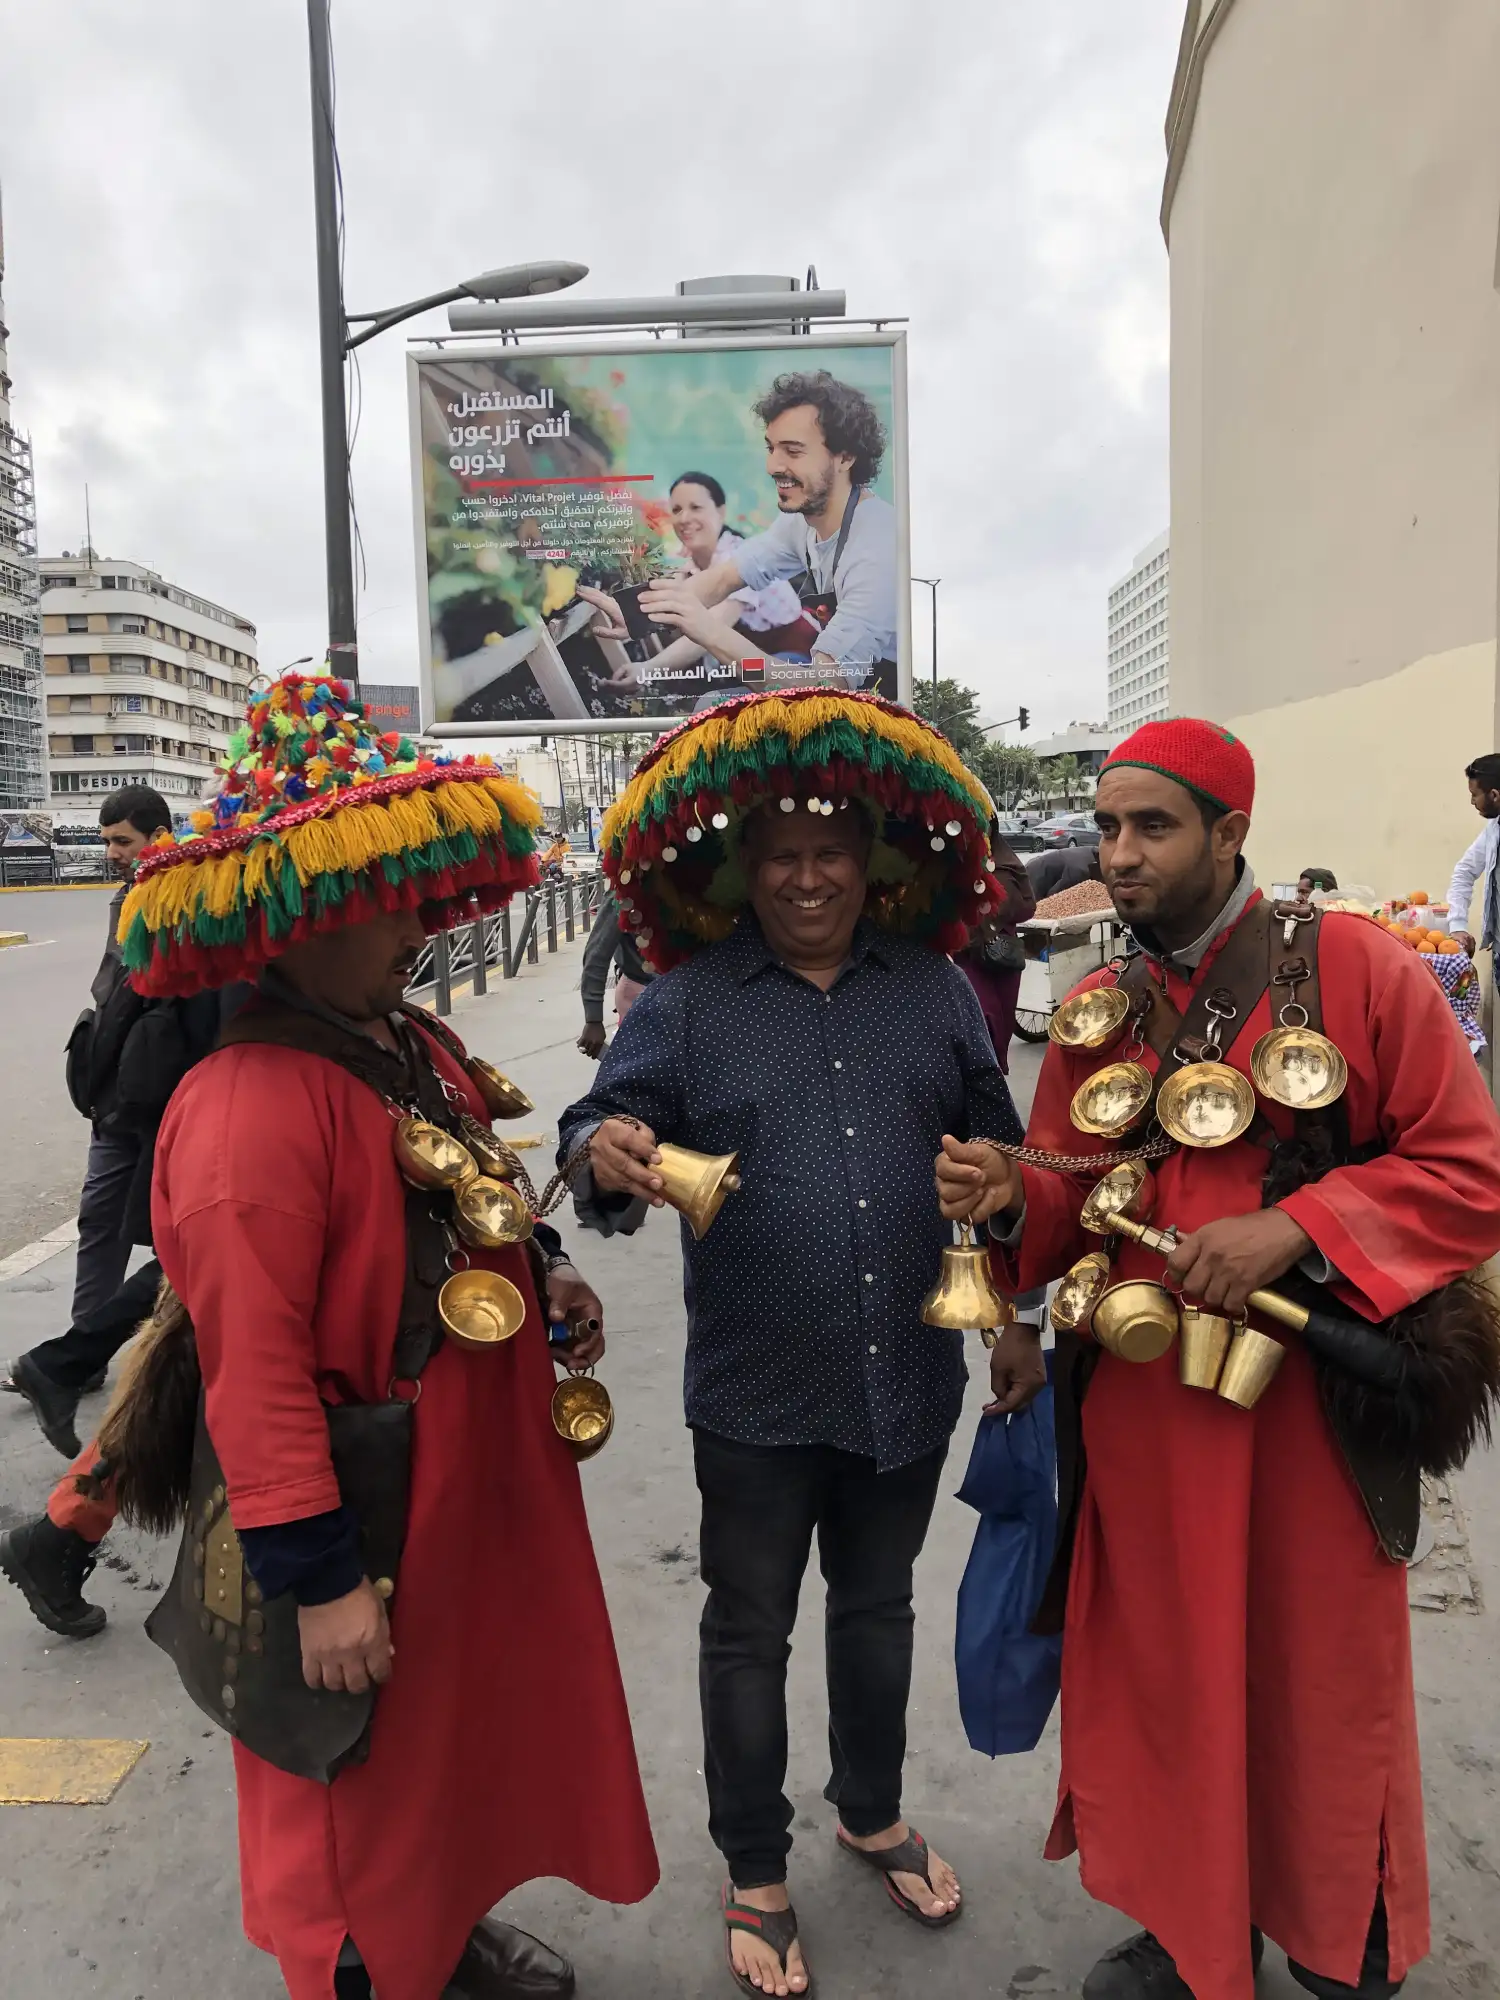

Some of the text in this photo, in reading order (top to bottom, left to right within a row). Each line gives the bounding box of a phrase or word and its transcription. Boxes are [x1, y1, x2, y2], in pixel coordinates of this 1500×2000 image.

[447, 388, 554, 418] المستقبل،
[448, 409, 571, 447] أنتم تزرعون
[449, 449, 506, 476] بذوره
[461, 497, 487, 508] حسب
[577, 491, 604, 503] توفير
[451, 503, 633, 522] وتيرتكم لتحقيق أحلامكم واستفيدوا من
[593, 517, 634, 531] توفيركم
[546, 550, 565, 558] 4242
[636, 660, 737, 685] أنتم المستقبل
